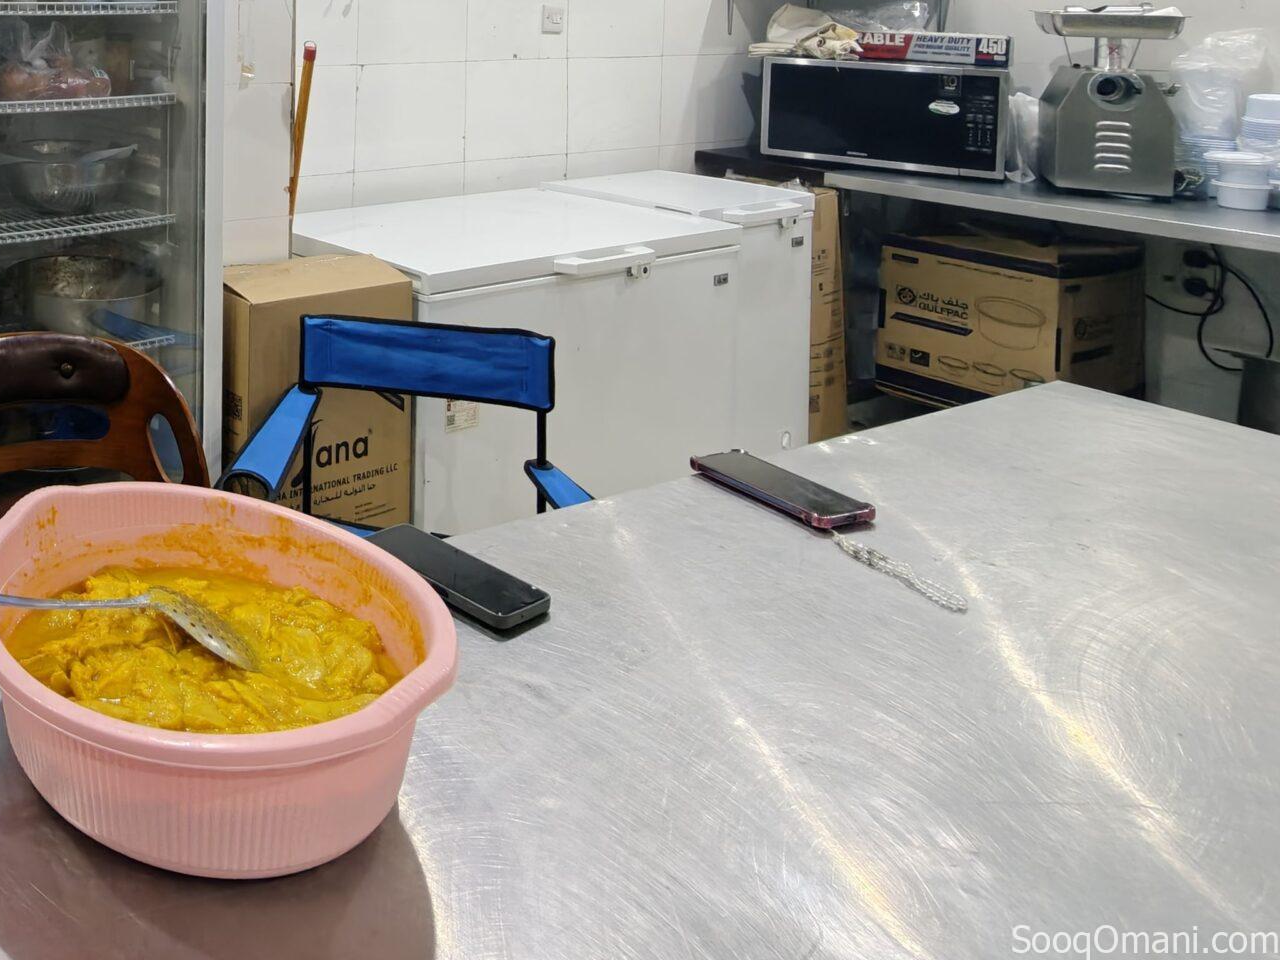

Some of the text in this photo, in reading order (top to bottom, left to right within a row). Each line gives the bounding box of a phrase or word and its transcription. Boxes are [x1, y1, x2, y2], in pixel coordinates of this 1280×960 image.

[916, 35, 971, 45] HEAVY DUTY
[979, 37, 1007, 54] 450
[289, 477, 350, 498] INTNATIONAL
[352, 467, 385, 483] TRADING
[385, 463, 399, 474] LLC
